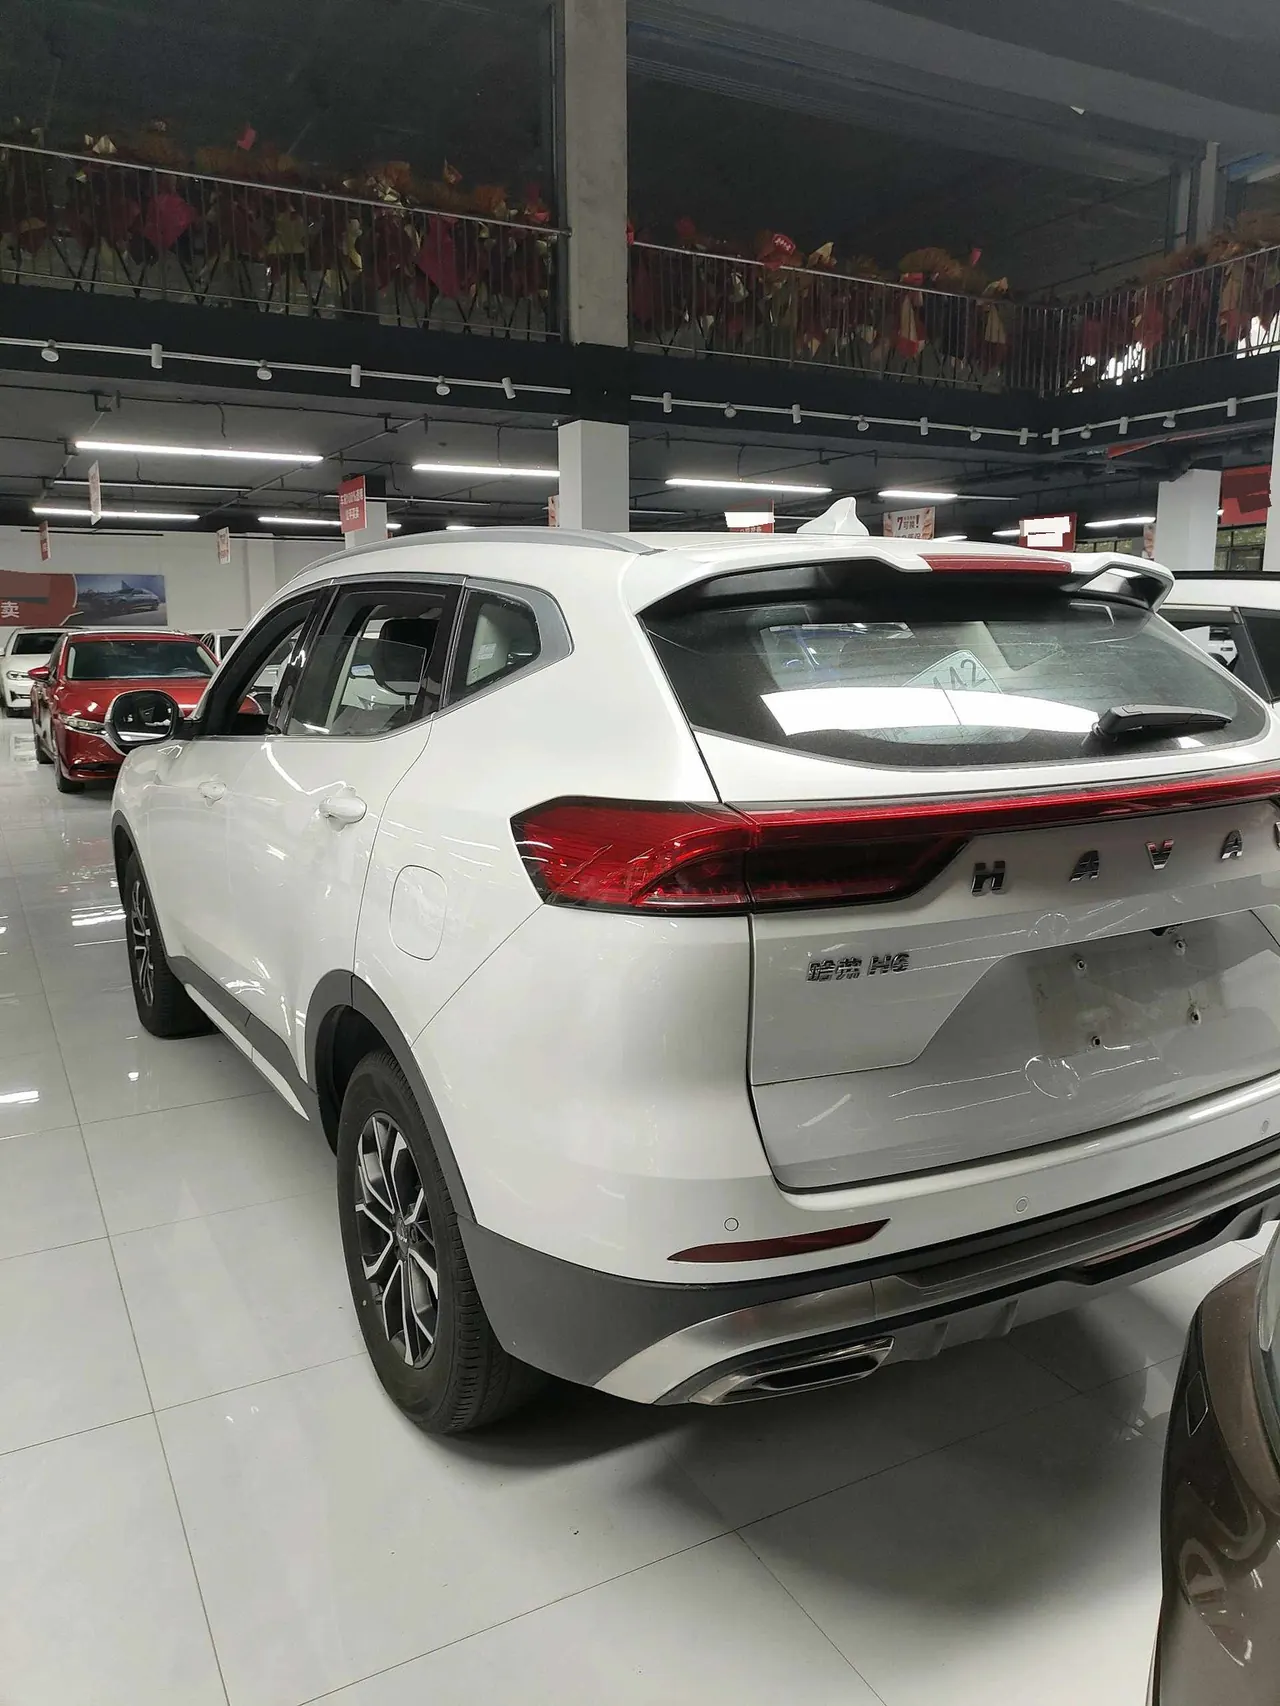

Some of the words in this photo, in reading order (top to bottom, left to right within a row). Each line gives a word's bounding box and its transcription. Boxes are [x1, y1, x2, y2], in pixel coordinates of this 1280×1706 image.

[1, 602, 20, 618] 卖
[971, 821, 1280, 896] HAVA
[867, 953, 910, 976] H6
